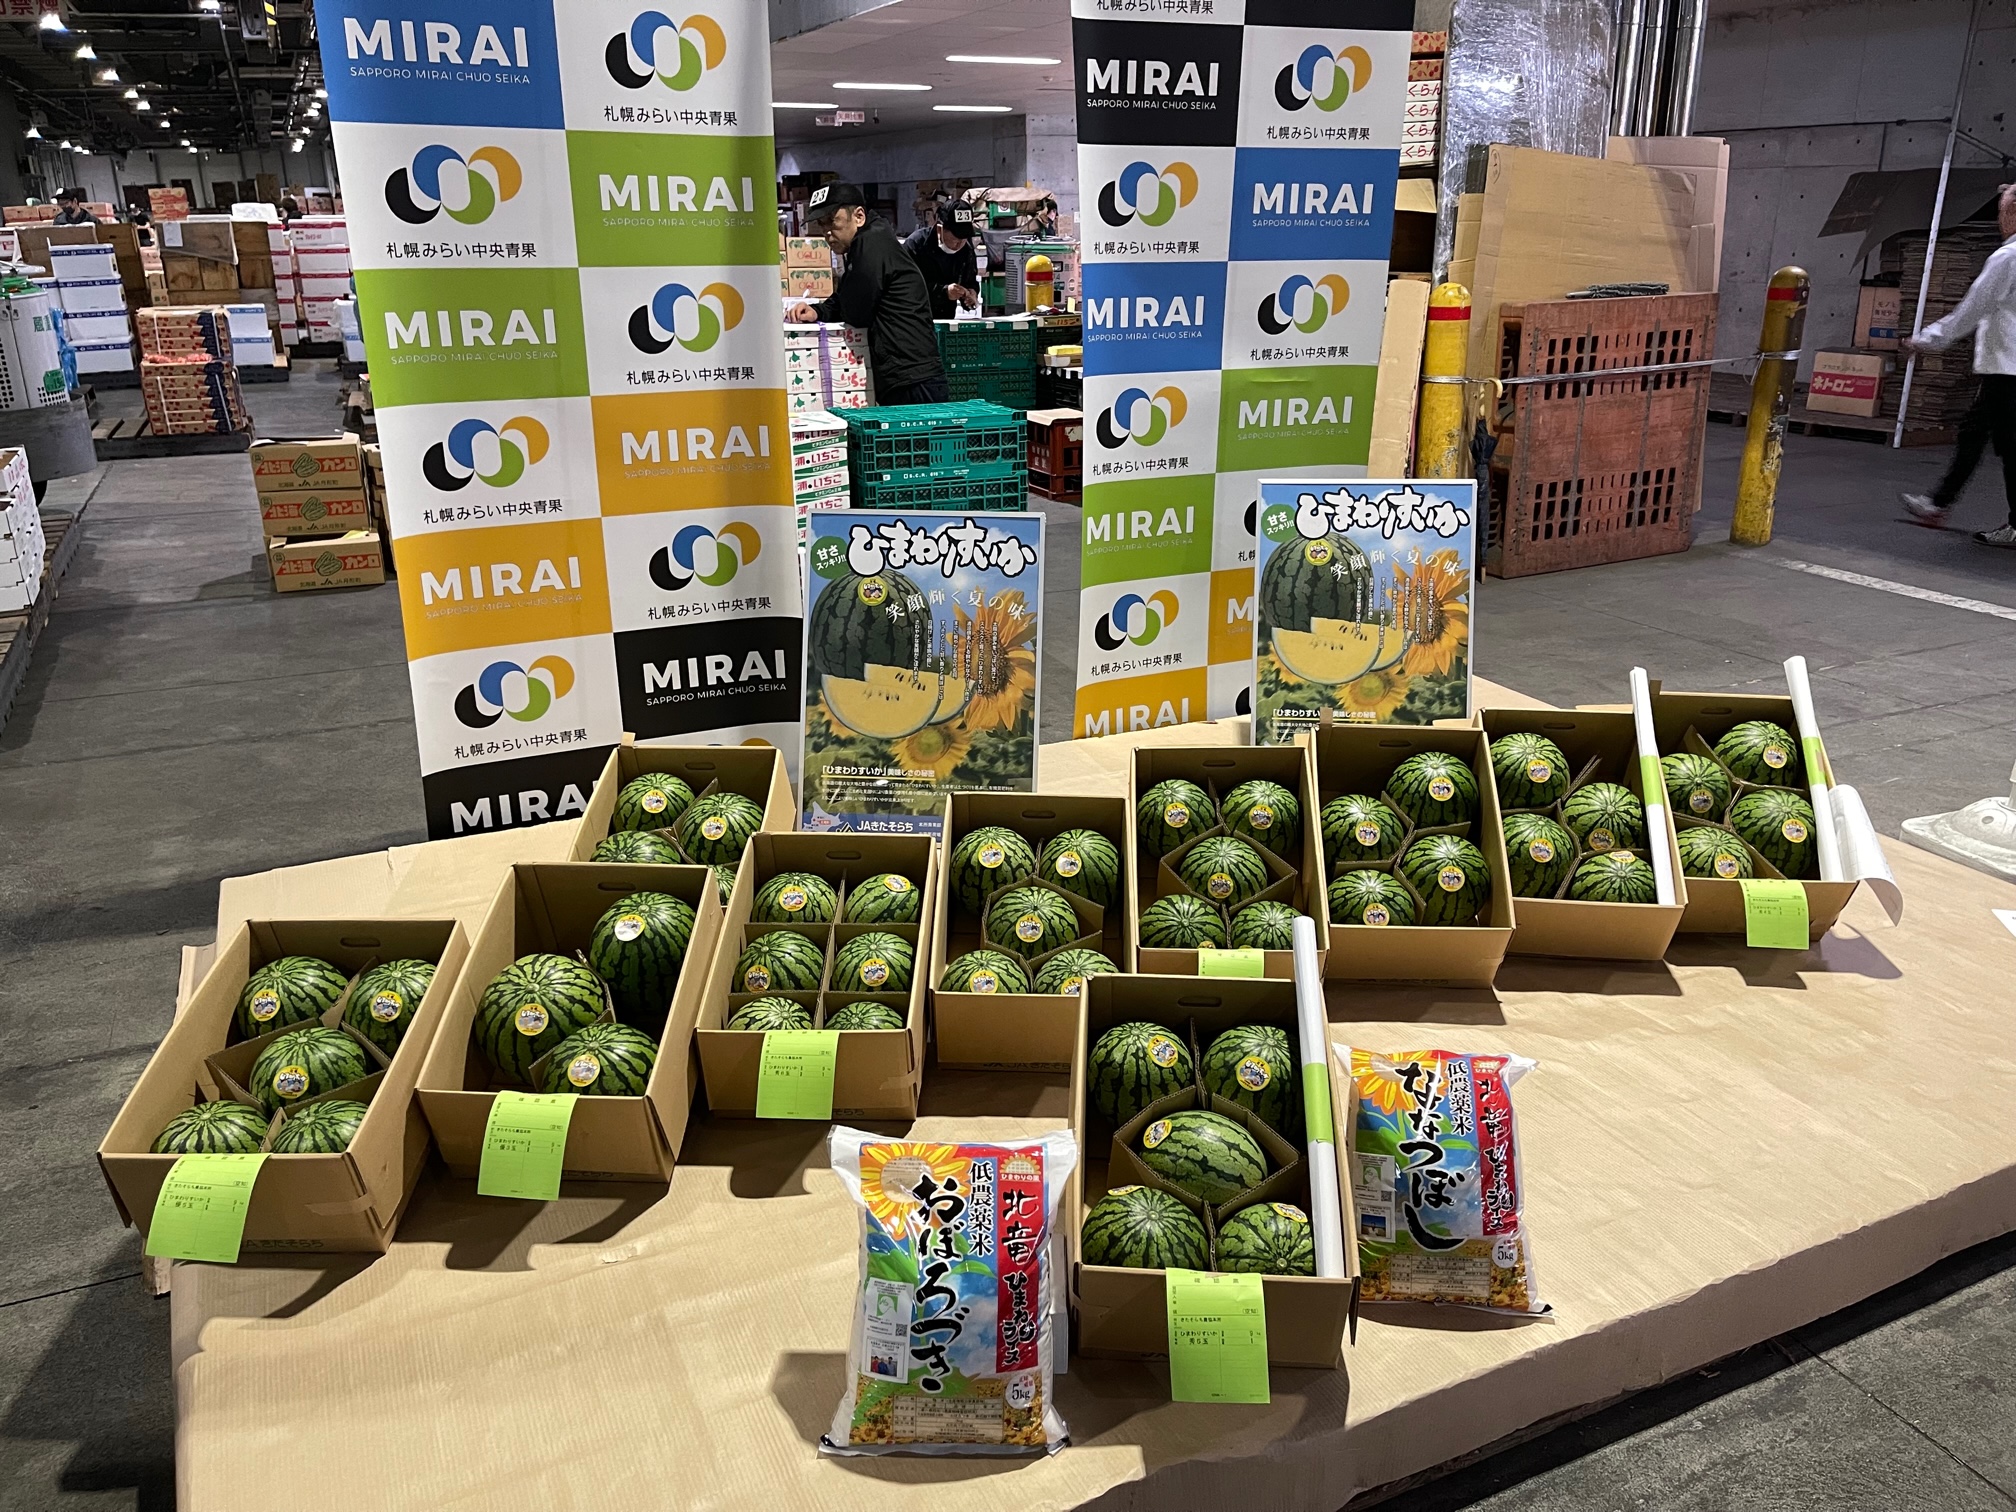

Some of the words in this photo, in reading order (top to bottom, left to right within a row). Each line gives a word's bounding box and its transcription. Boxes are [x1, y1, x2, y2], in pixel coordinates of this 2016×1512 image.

[344, 17, 528, 68] MIRAI
[350, 67, 412, 80] SAPPORO
[416, 70, 452, 80] MIRAI
[456, 72, 492, 82] CHUO
[495, 73, 530, 84] SEIKA
[1086, 58, 1219, 96] MIRAI
[604, 105, 737, 126] 札幌みらい中央青果
[1087, 99, 1130, 108] SAPPORO
[1132, 100, 1160, 109] MIRAI
[1162, 101, 1188, 109] CHUO
[1190, 102, 1216, 110] SEIKA
[1266, 126, 1370, 141] 札幌みらい中央青果
[599, 174, 754, 212] MIRAI
[812, 190, 826, 205] 23
[1253, 183, 1374, 214] MIRAI
[957, 210, 970, 220] 23
[386, 242, 536, 259] 札幌みらい中央青果
[1093, 241, 1200, 255] 札幌みらい中央青果
[1087, 296, 1205, 330] MIRAI
[384, 308, 557, 350] MIRAI
[1088, 334, 1123, 342] SAPPORO
[1250, 346, 1349, 362] 札幌みらい中央青果
[626, 367, 754, 385] 札幌みらい中央青果
[1813, 375, 1854, 393] ネトロン
[1238, 396, 1353, 429] MIRAI
[621, 425, 770, 466] MIRAI
[324, 458, 357, 471] カンロ
[1092, 456, 1189, 476] 札幌みらい中央青果
[331, 501, 364, 514] カンロ
[423, 498, 563, 525] 札幌みらい中央青果
[1267, 512, 1287, 524] 甘さ
[1296, 485, 1470, 540] ひまわりすいか
[1086, 506, 1194, 545] MIRAI
[817, 544, 838, 560] 甘さ
[848, 518, 1037, 578] ひまわりすいか
[345, 556, 380, 569] カンロ
[420, 556, 582, 606] MIRAI
[648, 596, 772, 621] 札幌みらい中央青果
[643, 648, 786, 694] MIRAI
[1091, 653, 1183, 677] 札幌みらい中央青果
[646, 692, 694, 706] SAPPORO
[697, 688, 725, 699] MIRAI
[728, 686, 755, 696] CHUO
[758, 683, 786, 693] SEIKA
[1085, 697, 1189, 738] MIRAI
[454, 728, 587, 760] 札幌みらい中央青果
[450, 780, 598, 832] MIRA
[857, 820, 913, 832] JAきたそらち
[1447, 1062, 1474, 1135] 低農薬米
[1395, 1062, 1469, 1251] ななつぼし
[968, 1161, 993, 1256] 低農薬米
[1002, 1189, 1040, 1265] 北竜
[1497, 1245, 1514, 1261] 5kg
[911, 1174, 970, 1391] おぼろづき
[1012, 1383, 1030, 1400] 5kg
